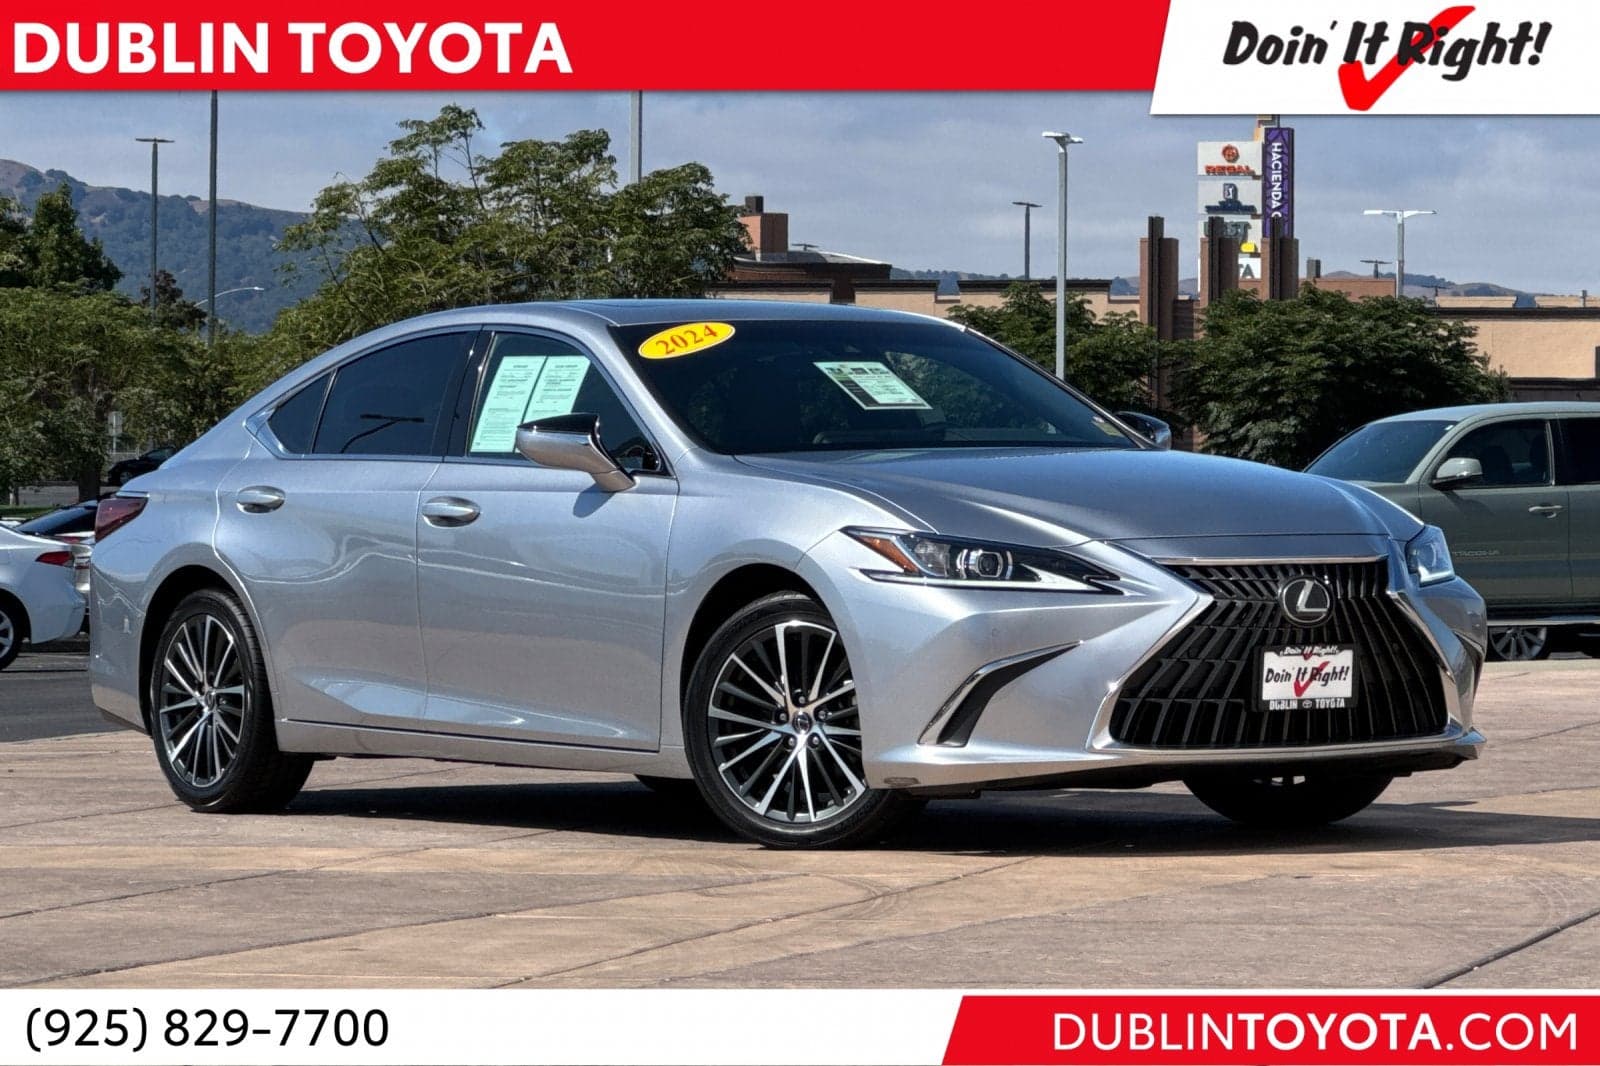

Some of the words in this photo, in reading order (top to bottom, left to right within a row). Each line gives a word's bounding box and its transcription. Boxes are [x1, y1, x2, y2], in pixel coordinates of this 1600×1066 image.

[1271, 142, 1283, 209] HACIENDA
[656, 324, 718, 355] 2024
[1296, 666, 1308, 682] It
[1310, 666, 1350, 687] Right!
[1269, 699, 1298, 711] DUBLIN
[1315, 698, 1345, 709] TOYOTA
